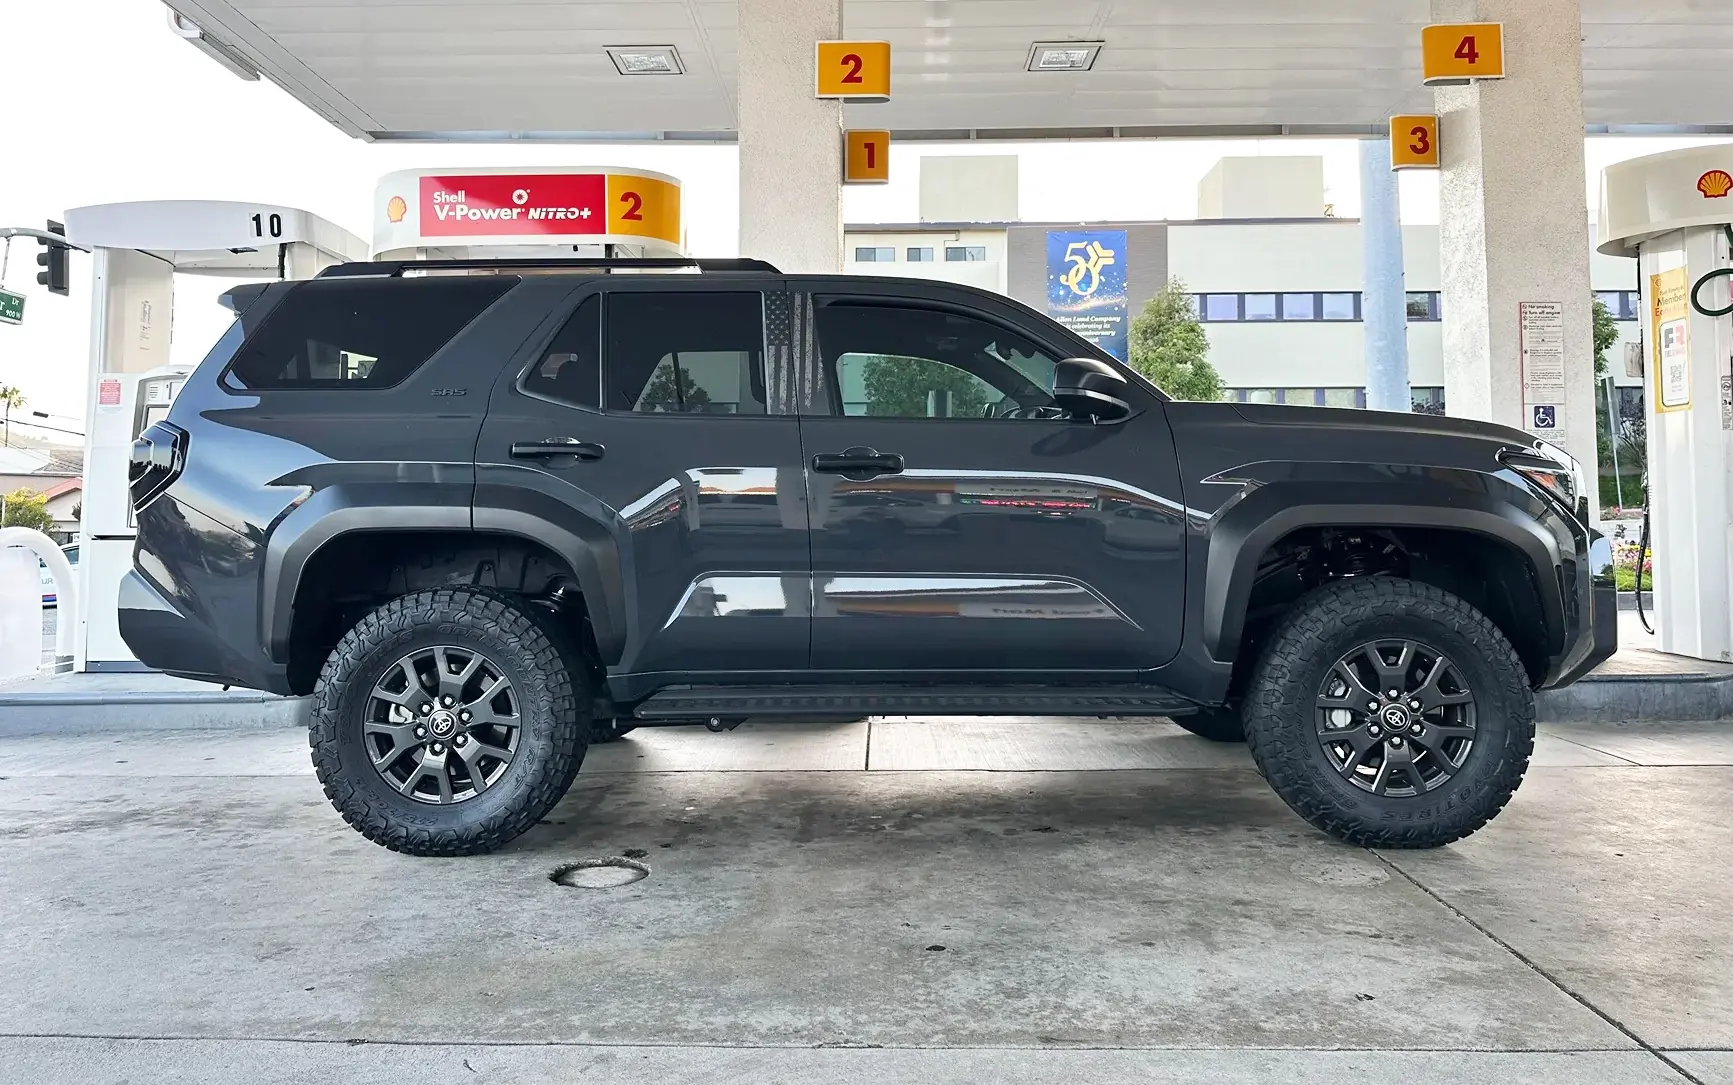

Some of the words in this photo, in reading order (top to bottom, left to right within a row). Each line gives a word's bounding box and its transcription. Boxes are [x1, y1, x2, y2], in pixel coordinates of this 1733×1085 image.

[1454, 36, 1480, 65] 4
[840, 53, 863, 84] 2
[1409, 126, 1430, 155] 3
[863, 142, 876, 169] 1
[433, 190, 466, 203] Shell
[619, 191, 643, 220] 2
[251, 213, 282, 237] 10
[433, 204, 521, 221] V-Power
[5, 309, 16, 318] 900
[12, 297, 20, 306] Dr
